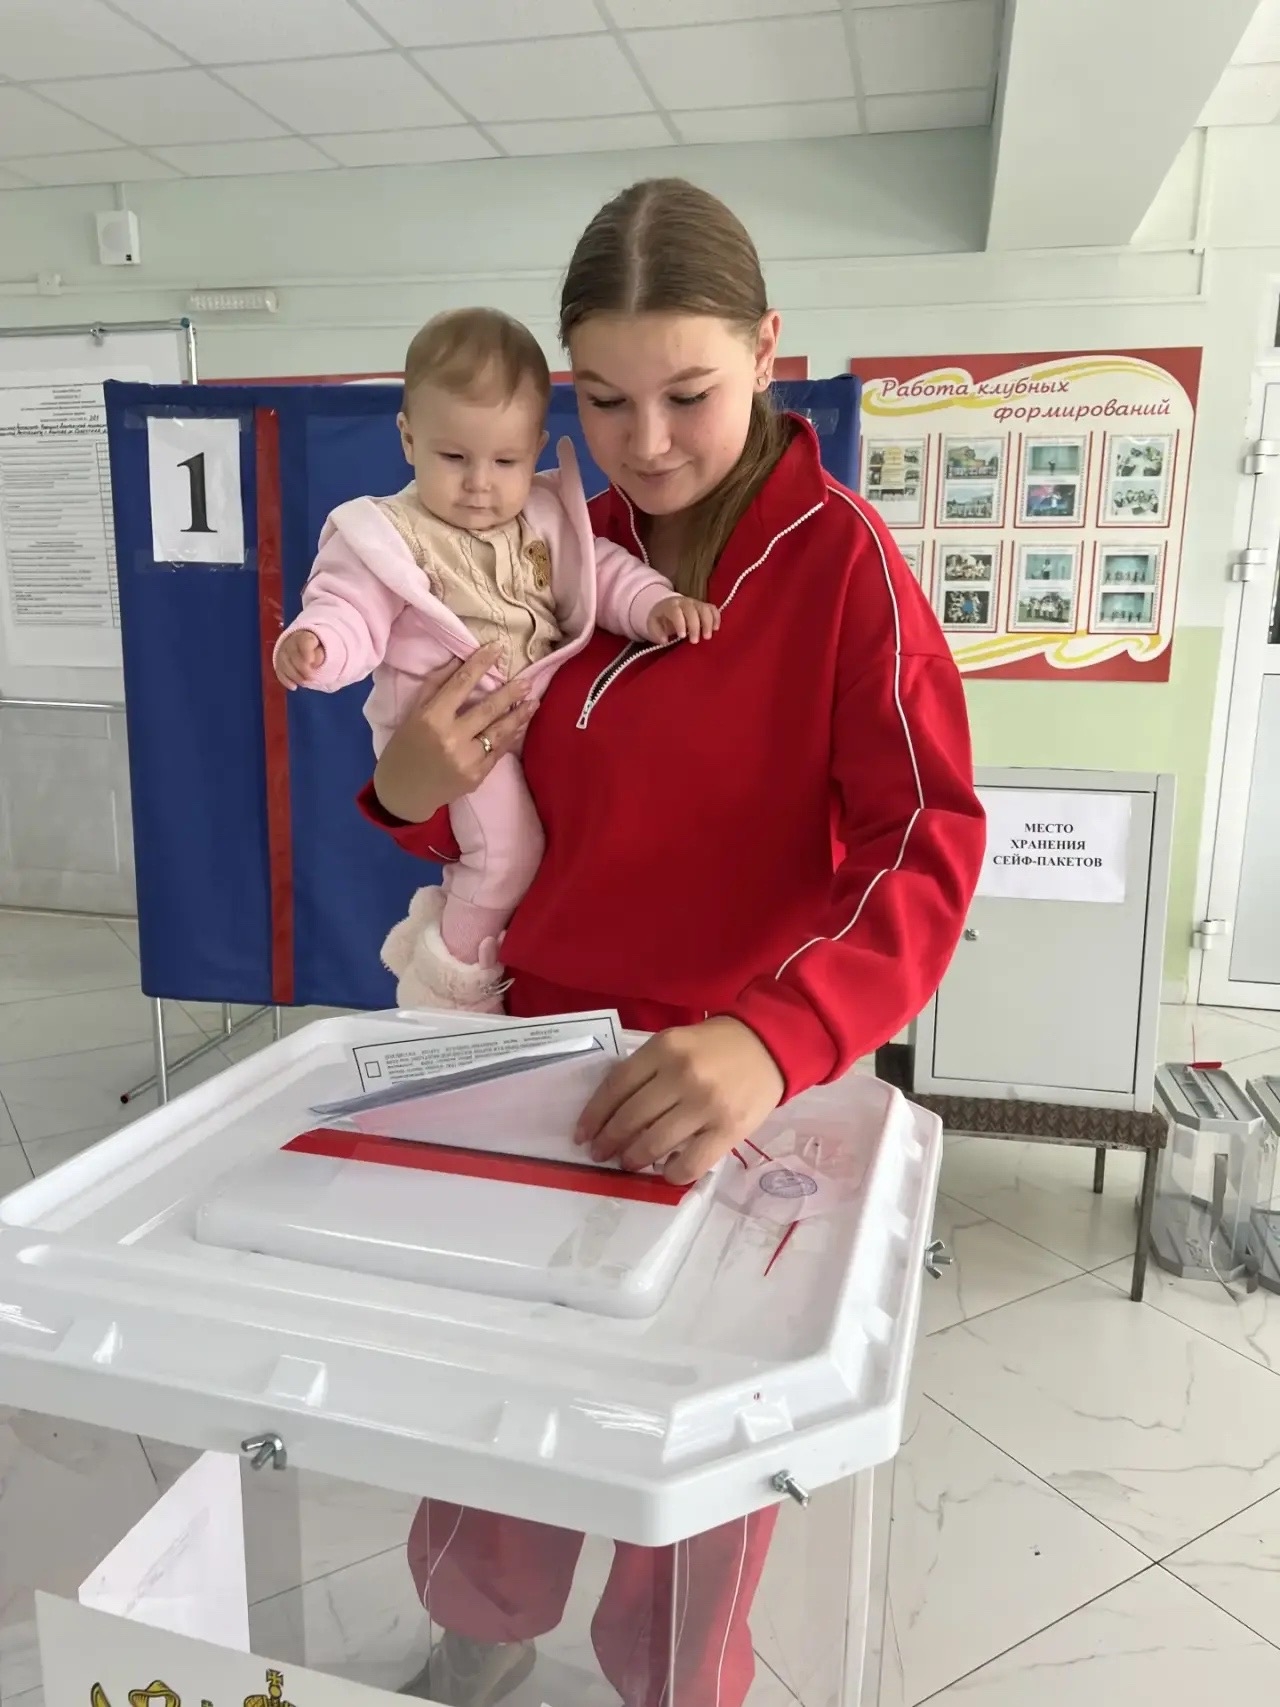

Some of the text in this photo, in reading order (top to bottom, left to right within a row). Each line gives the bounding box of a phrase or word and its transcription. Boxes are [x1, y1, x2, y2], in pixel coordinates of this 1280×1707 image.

[881, 377, 1070, 400] Работа клубных
[993, 398, 1170, 423] формирований
[176, 451, 218, 533] 1
[1024, 823, 1074, 834] МЕСТО
[1010, 838, 1086, 851] ХРАНЕНИЯ
[993, 853, 1103, 867] СЕЙФ-ПАКЕТОВ
